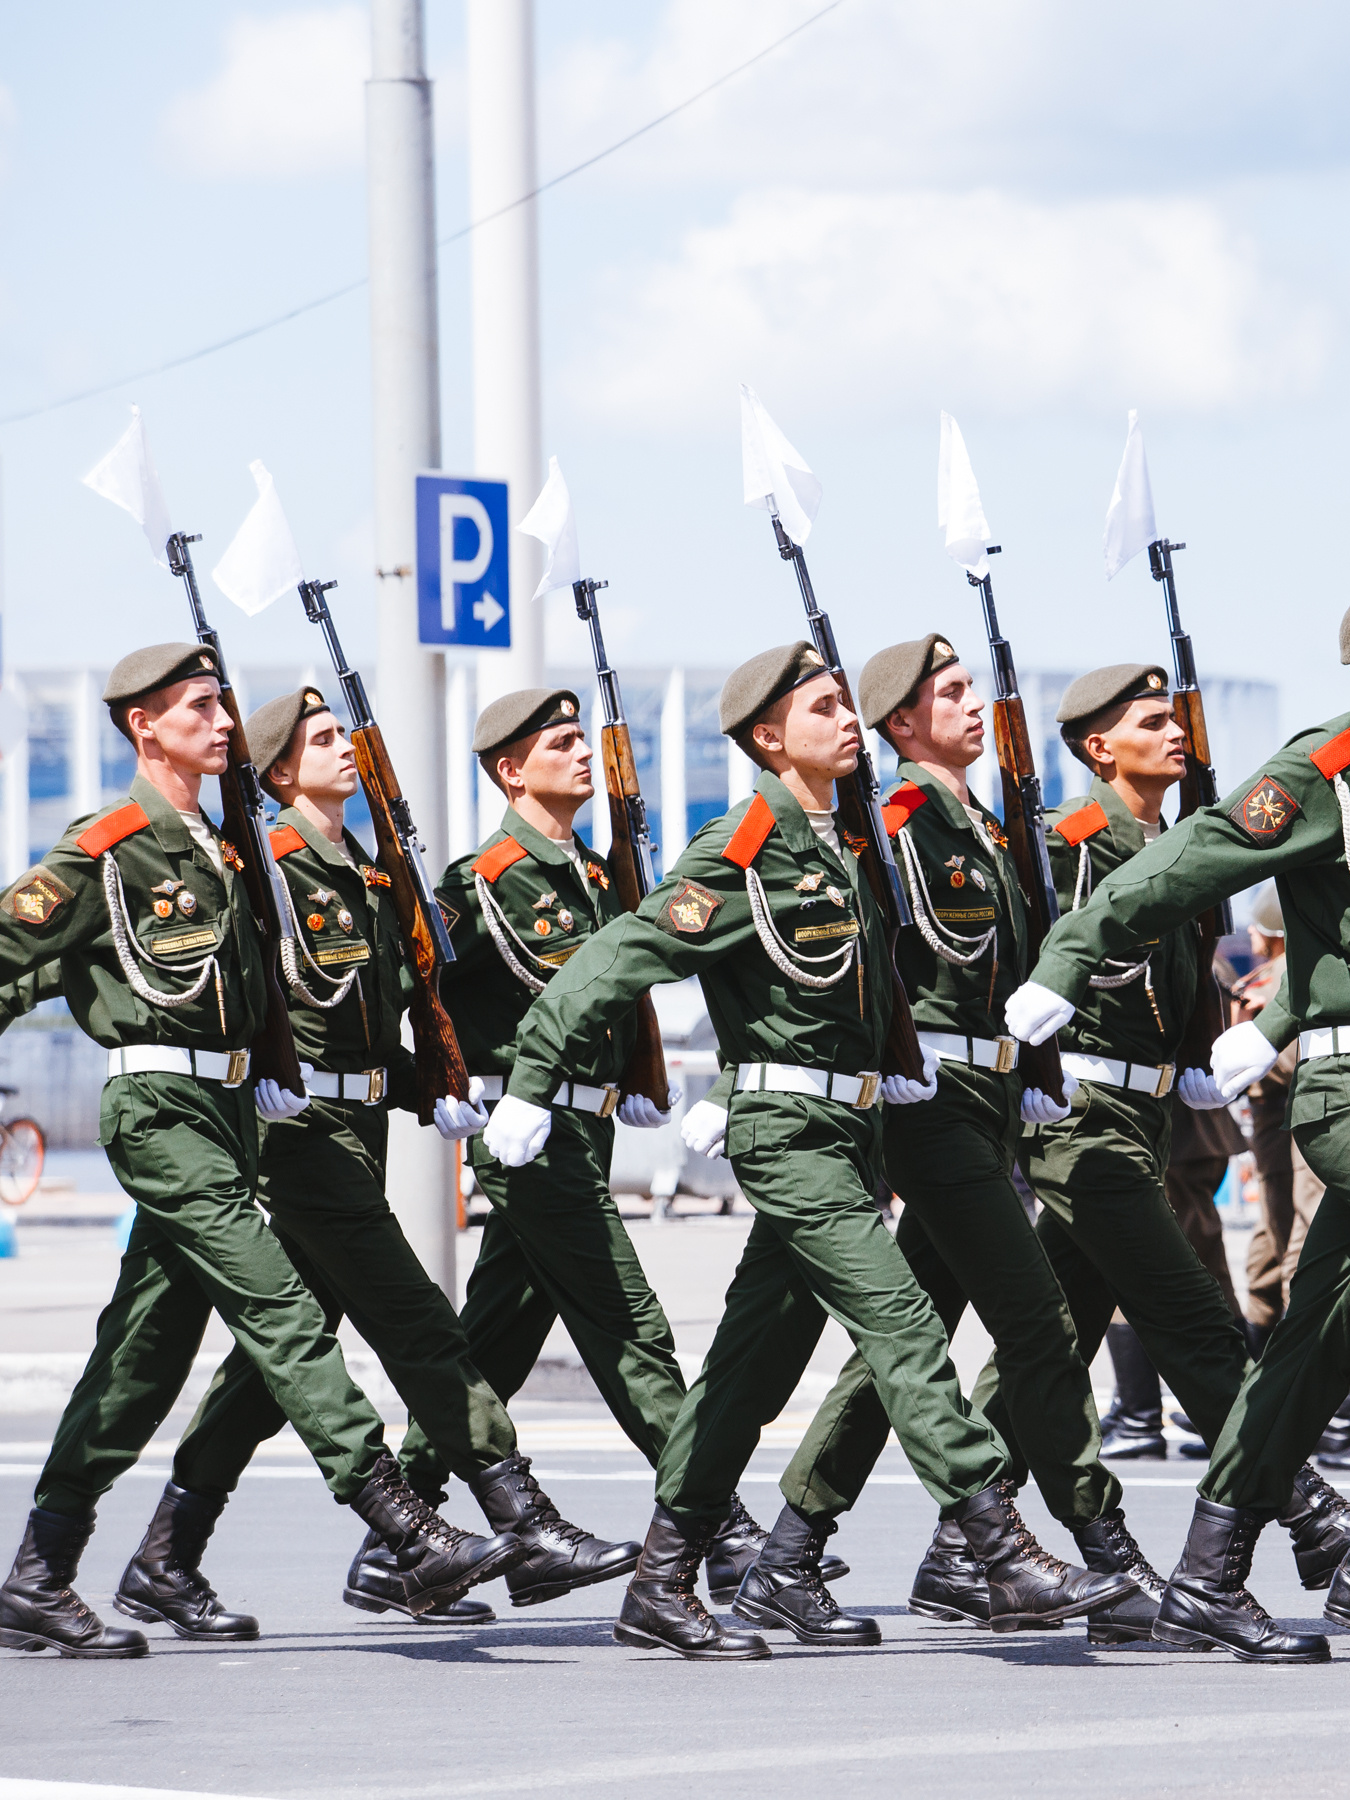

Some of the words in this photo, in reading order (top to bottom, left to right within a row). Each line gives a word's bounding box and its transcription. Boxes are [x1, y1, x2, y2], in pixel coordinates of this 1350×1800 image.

[439, 493, 494, 631] P
[35, 880, 59, 902] РОССИЯ
[687, 889, 713, 908] РОССИЯ
[797, 927, 830, 938] ВООРУЖЕННЫЕ
